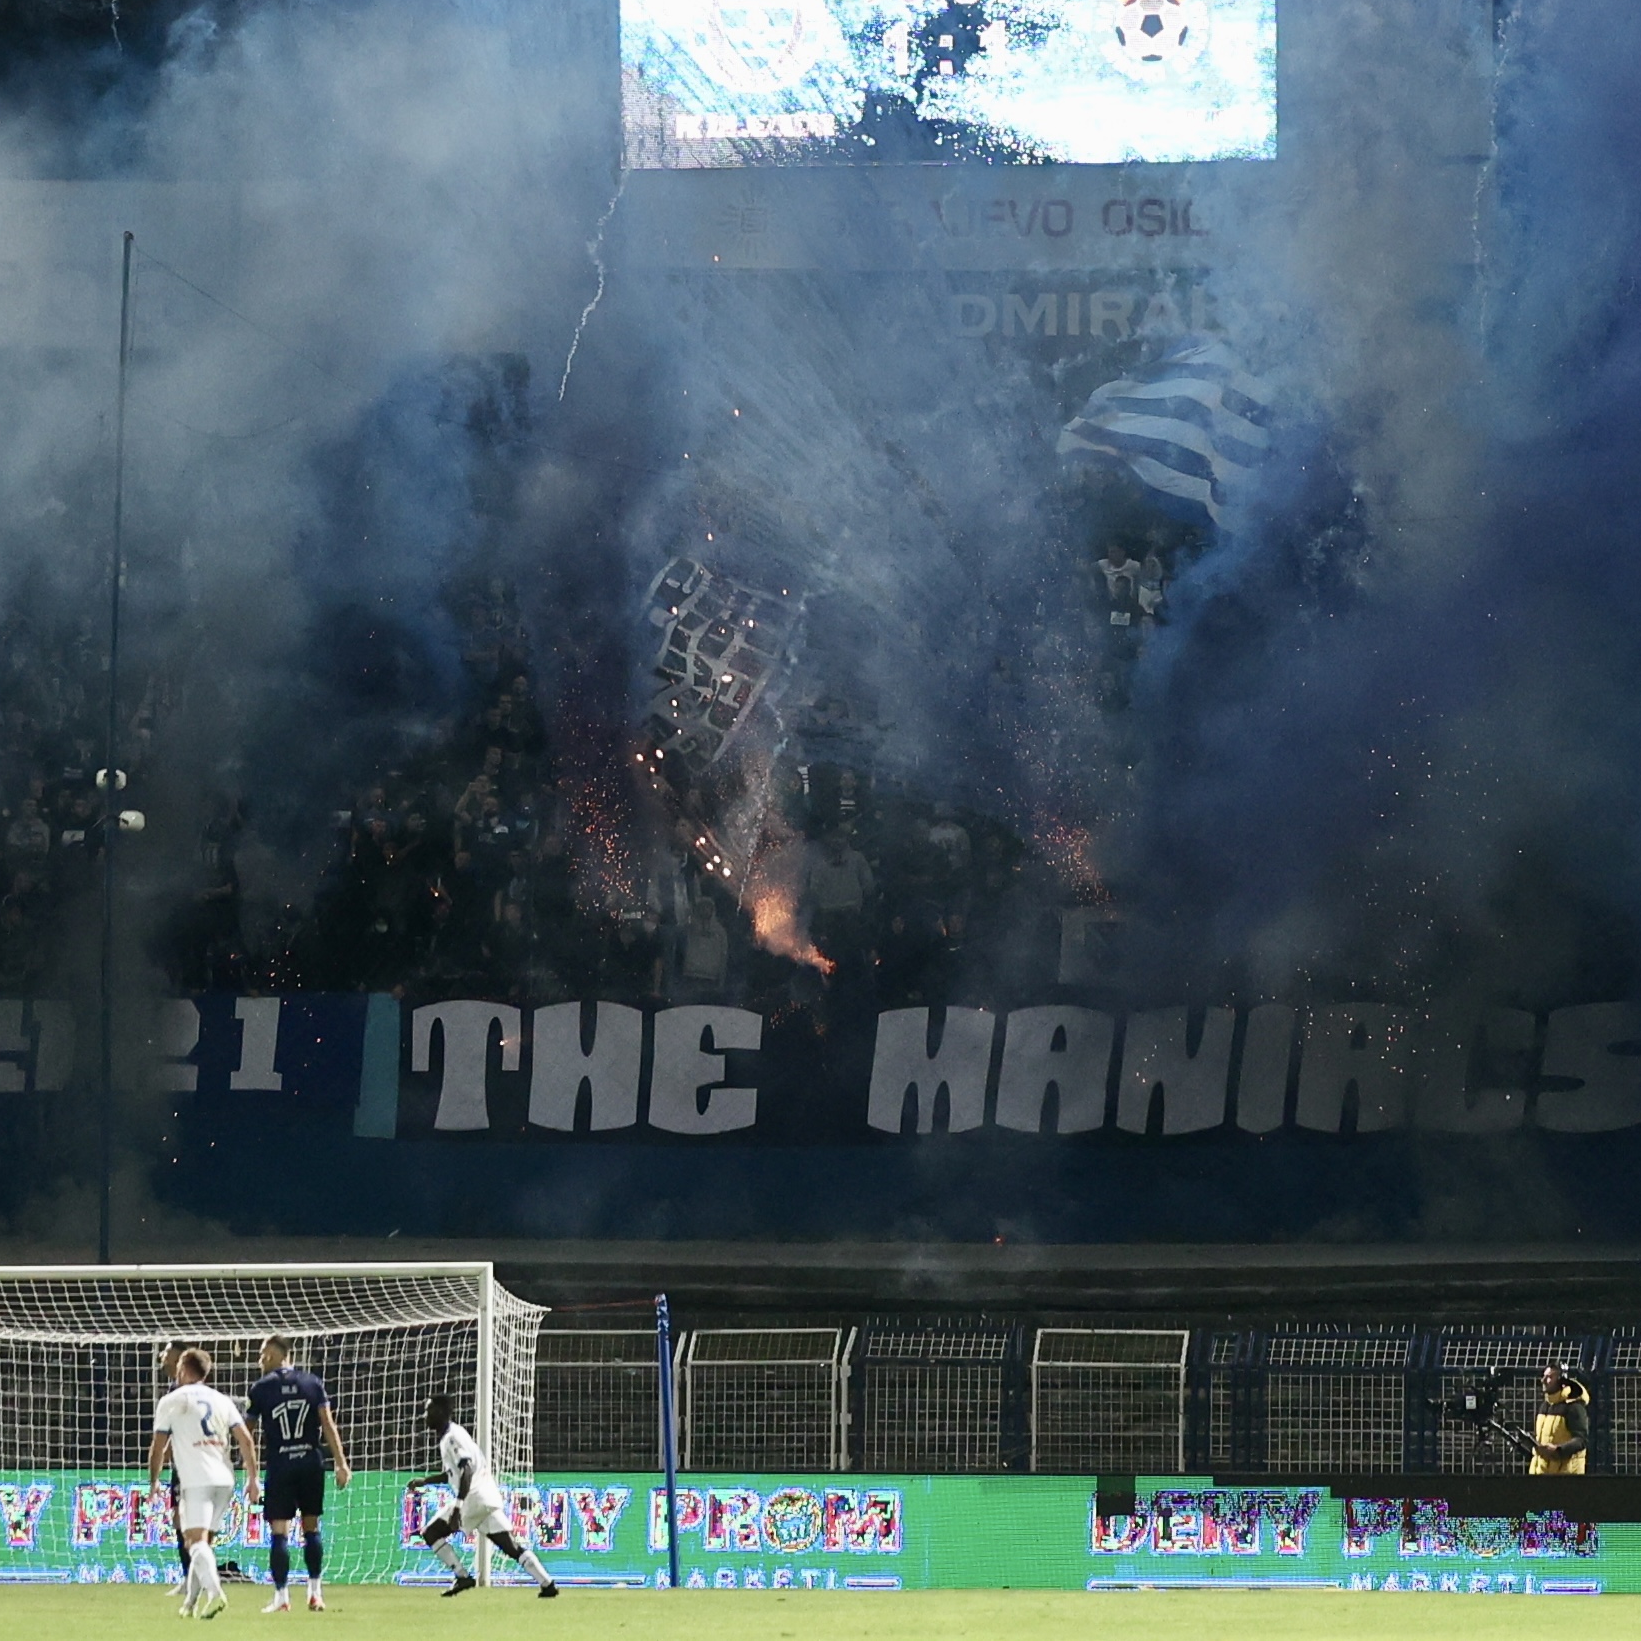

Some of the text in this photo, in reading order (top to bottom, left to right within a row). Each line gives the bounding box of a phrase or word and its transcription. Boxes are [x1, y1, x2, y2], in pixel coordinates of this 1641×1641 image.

[411, 1000, 761, 1135] THE
[271, 1399, 311, 1440] 17
[649, 1487, 904, 1553] PROM
